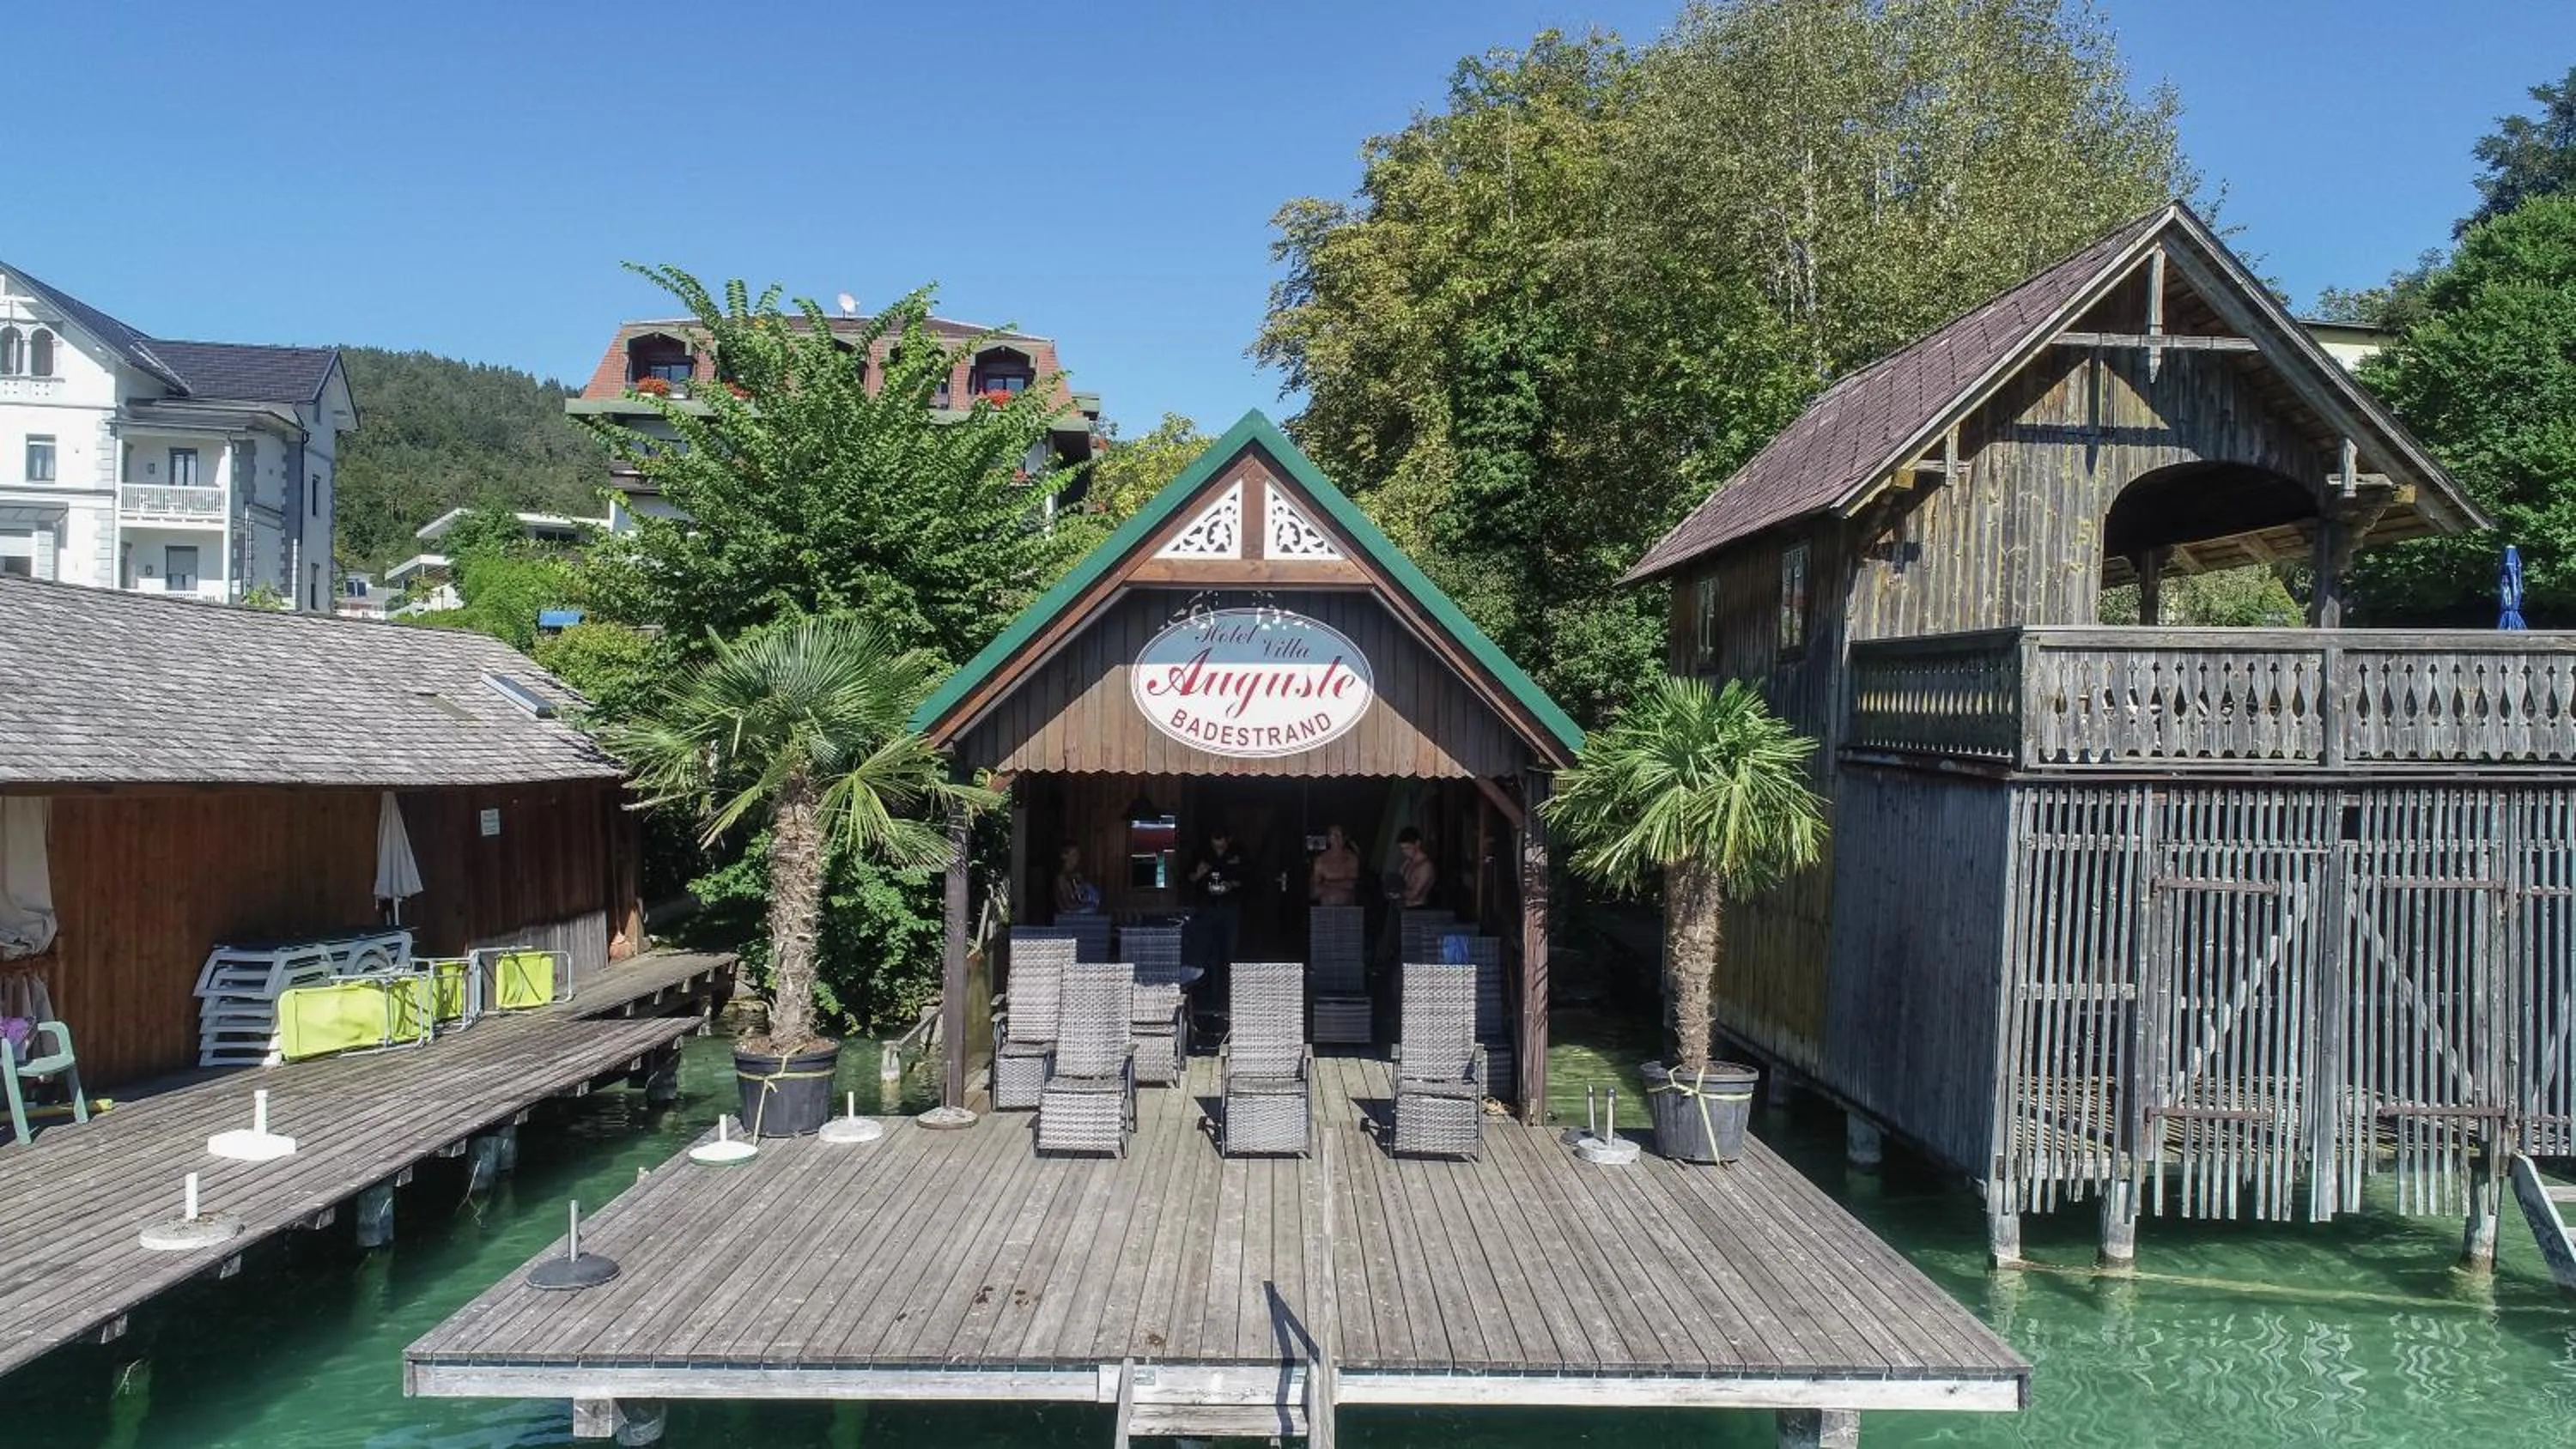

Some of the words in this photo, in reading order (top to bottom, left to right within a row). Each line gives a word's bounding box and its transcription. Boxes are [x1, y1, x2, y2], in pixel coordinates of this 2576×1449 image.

[1194, 625, 1259, 645] Hotel
[1262, 638, 1309, 658] Villa
[1147, 646, 1356, 718] Auguste
[1170, 709, 1332, 746] BADESTRAND
